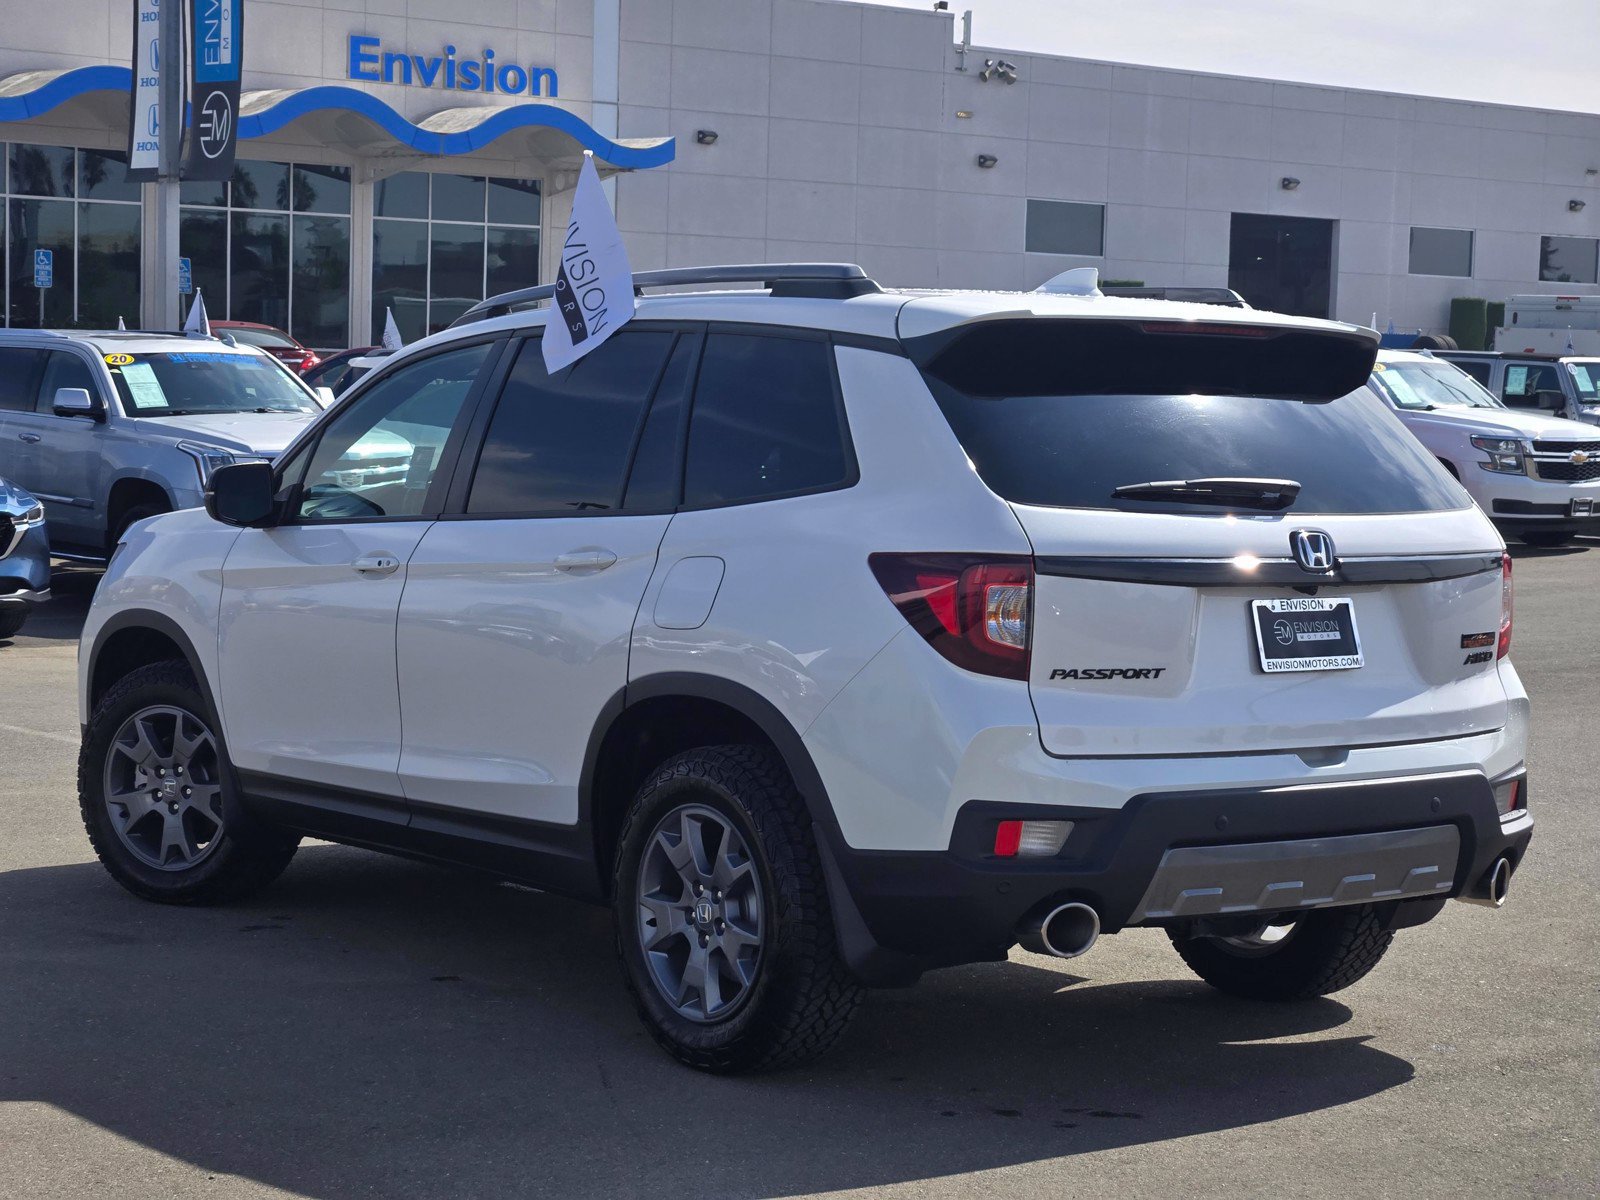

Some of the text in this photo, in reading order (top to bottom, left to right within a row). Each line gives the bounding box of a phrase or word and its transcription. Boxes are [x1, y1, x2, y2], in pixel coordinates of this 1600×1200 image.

[349, 35, 559, 98] Envision
[564, 221, 608, 336] VISION
[556, 279, 583, 332] ORS
[111, 355, 127, 364] 20
[1280, 600, 1324, 611] ENVISION
[1293, 620, 1340, 633] ENVISION
[1266, 657, 1360, 670] ENVISIONMOTORS.COM
[1049, 668, 1166, 680] PASSPORT
